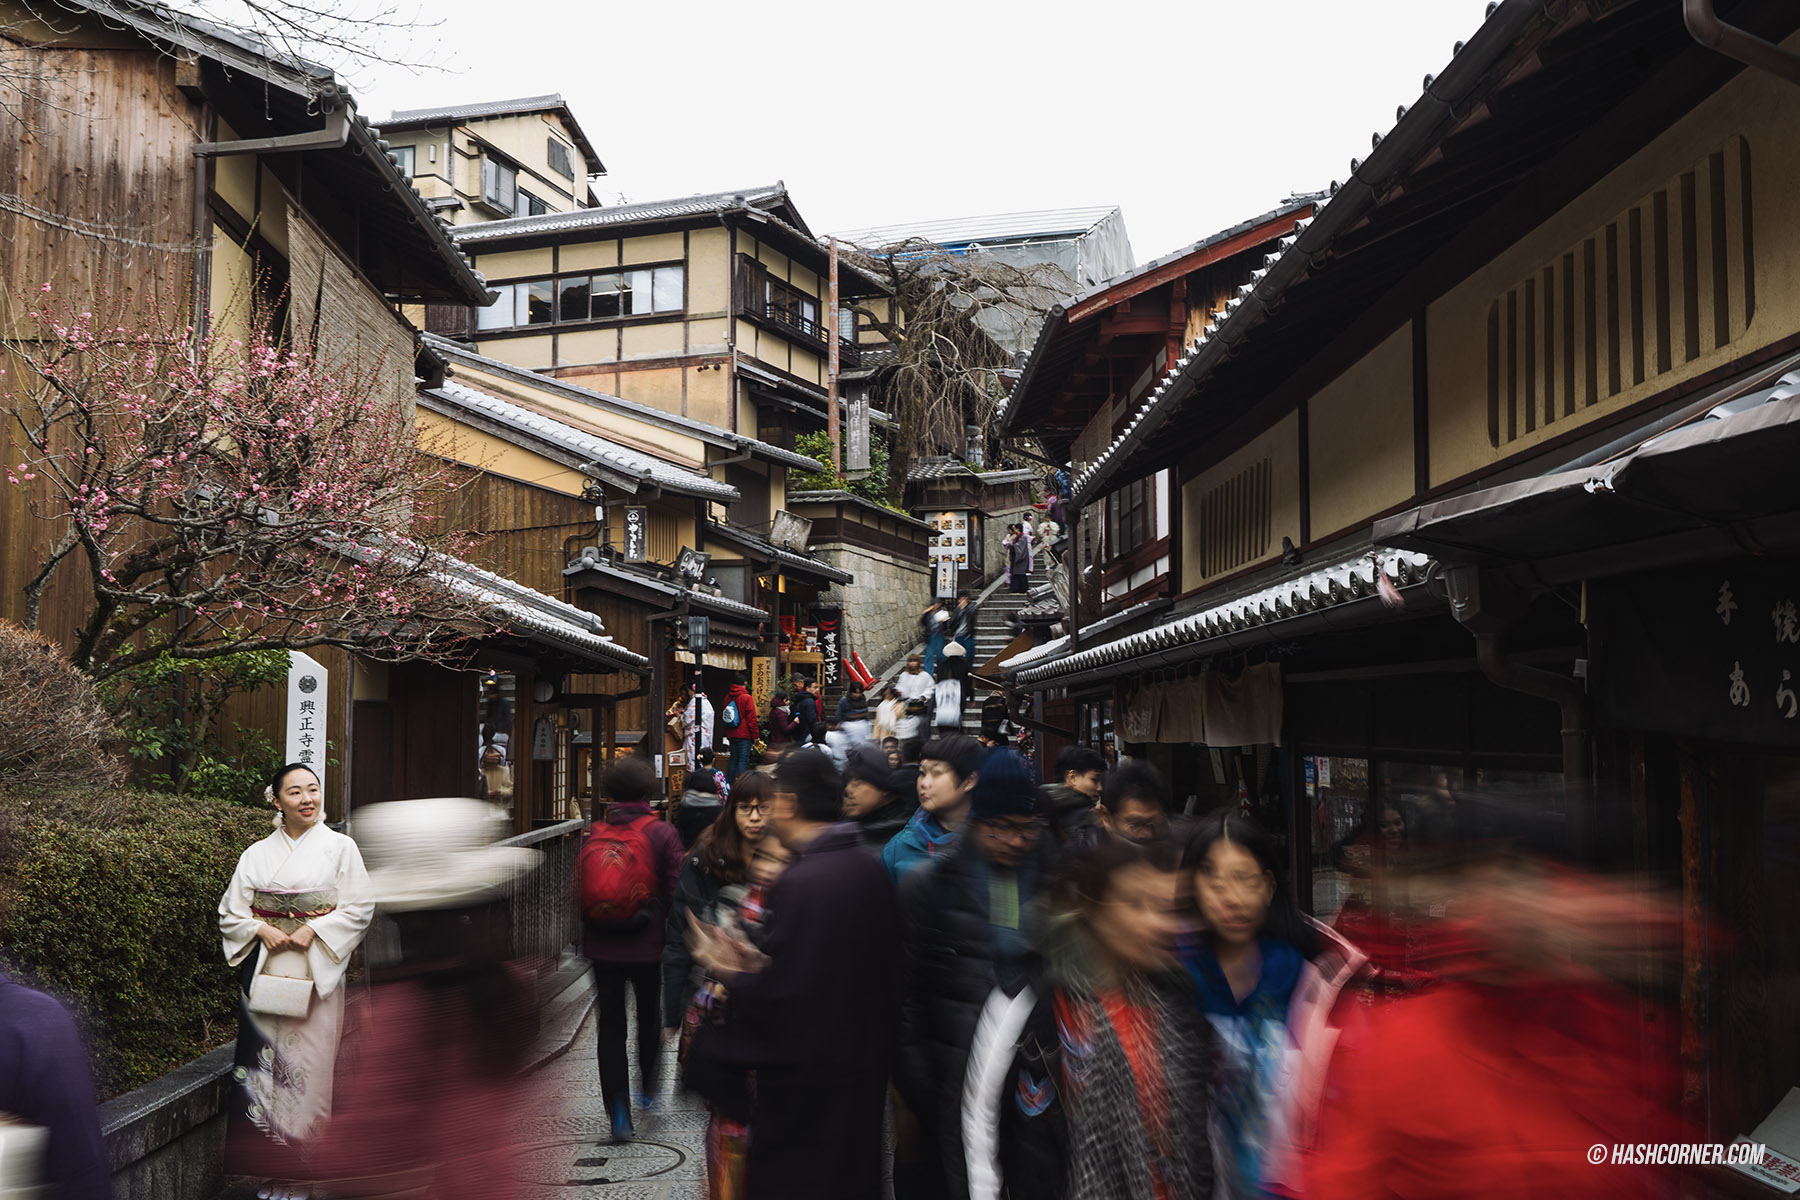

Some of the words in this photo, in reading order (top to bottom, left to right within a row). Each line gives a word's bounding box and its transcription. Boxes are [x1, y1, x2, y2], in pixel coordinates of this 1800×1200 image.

[823, 632, 839, 684] 世界一辛い
[1729, 660, 1799, 719] あら
[298, 700, 316, 764] 興正寺霊
